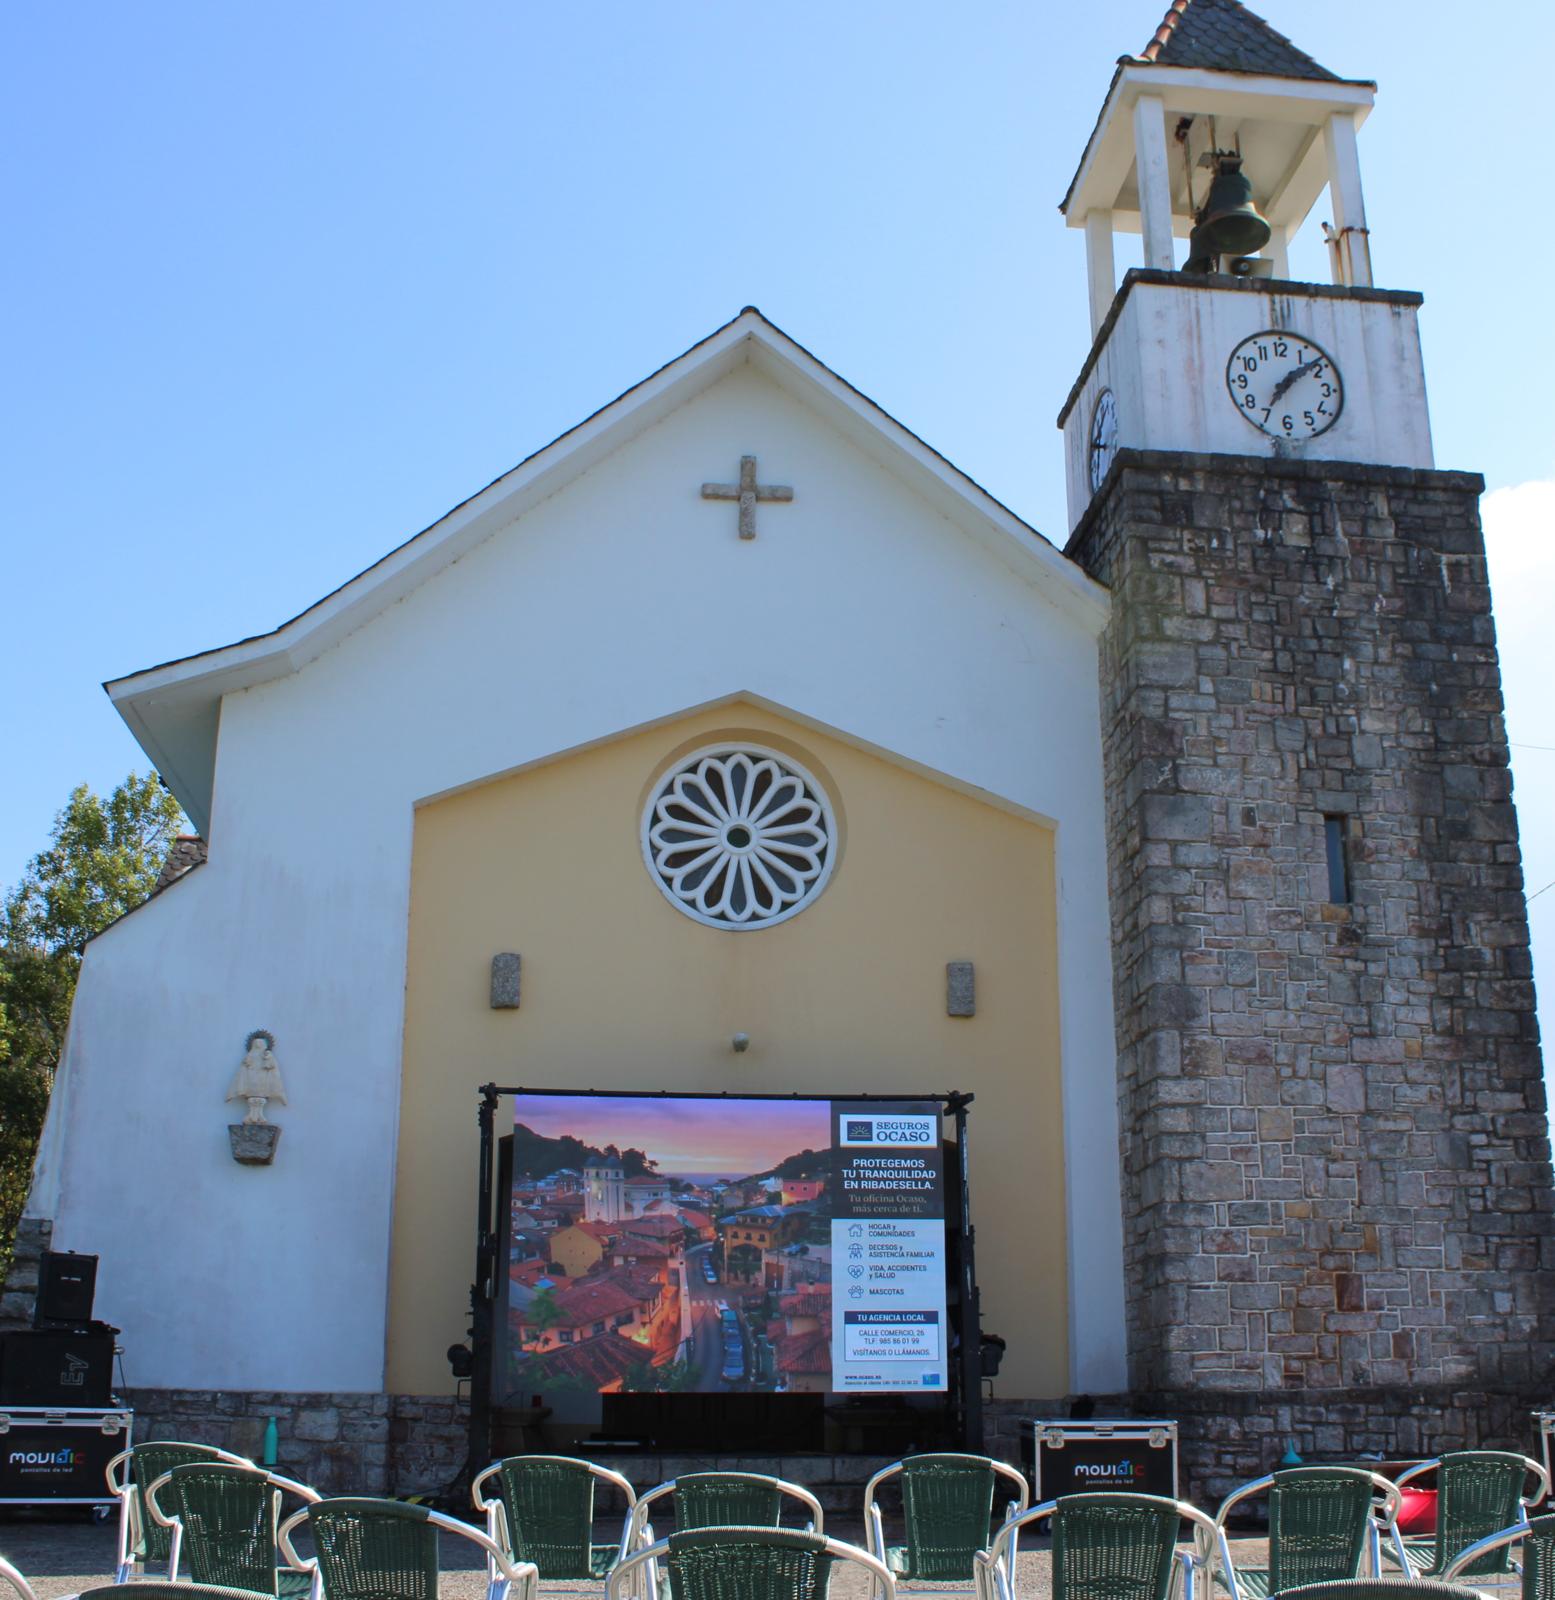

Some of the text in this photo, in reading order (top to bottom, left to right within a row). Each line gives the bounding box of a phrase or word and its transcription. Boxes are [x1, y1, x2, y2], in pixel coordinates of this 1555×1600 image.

[1258, 346, 1268, 361] 11
[1273, 342, 1288, 358] 12
[1297, 349, 1303, 365] 1
[1242, 357, 1257, 372] 10
[1313, 363, 1322, 379] 2
[1237, 374, 1248, 389] 9
[1320, 383, 1331, 398] 3
[1244, 394, 1256, 409] 8
[1317, 401, 1327, 416] 4
[1261, 408, 1271, 423] 7
[1282, 415, 1293, 430] 6
[1303, 411, 1315, 426] 5
[876, 1121, 930, 1130] SEGUROS
[876, 1131, 930, 1142] OCASO
[853, 1159, 925, 1168] PROTEGEMOS
[842, 1169, 936, 1179] TU TRANQUILIDAD
[844, 1180, 934, 1190] EN RIBADESELLA.
[849, 1194, 861, 1203] Tu
[863, 1194, 894, 1203] oficina
[899, 1205, 911, 1213] de
[858, 1329, 879, 1337] CALLE
[880, 1329, 915, 1338] COMERCIO,
